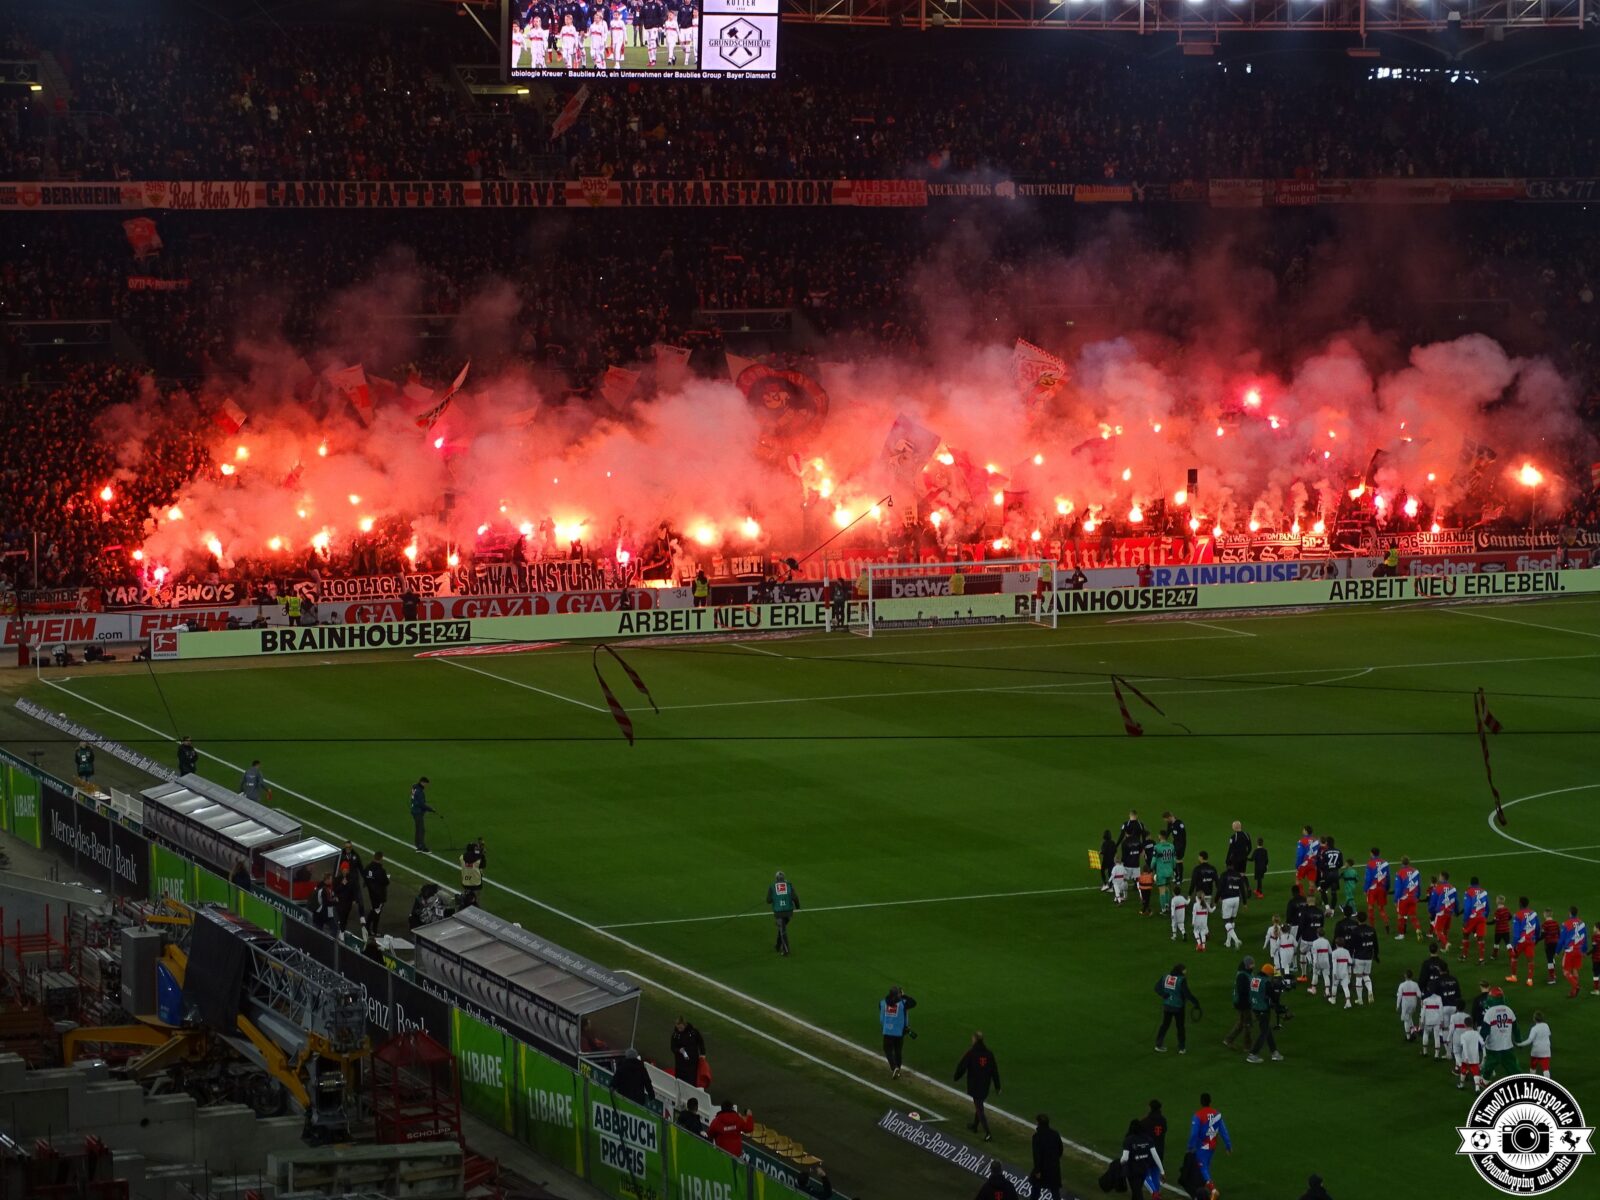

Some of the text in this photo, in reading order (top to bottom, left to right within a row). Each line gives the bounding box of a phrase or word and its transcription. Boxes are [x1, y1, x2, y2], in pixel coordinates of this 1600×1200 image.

[709, 39, 771, 48] GRUNDSCHMIEDE
[702, 71, 722, 80] Group
[727, 72, 745, 80] Bayer
[41, 186, 122, 205] BERKHEIM
[169, 181, 197, 209] Red
[233, 181, 251, 208] 96
[266, 182, 465, 208] CANNSTATTER
[481, 182, 567, 207] KURVE
[621, 181, 833, 206] NECKARSTADION
[928, 184, 992, 196] NECKAR-FILS
[1018, 183, 1075, 196] STUTTGART
[1478, 530, 1561, 549] Cannstatte
[176, 583, 235, 603] BWOYS
[320, 575, 435, 598] HOOLIGANS
[892, 577, 953, 598] betwa
[1329, 571, 1566, 601] ARBEIT NEU ERLEBEN.
[356, 601, 435, 624] GAI
[462, 597, 539, 618] GAZI
[618, 609, 706, 634] ARBEIT
[714, 605, 762, 629] NEU
[5, 617, 97, 645] EHEIM
[50, 808, 112, 870] Mercedes-Benz
[115, 844, 138, 885] Bank
[1327, 852, 1339, 866] 27
[461, 1050, 504, 1089] LIBARE
[528, 1087, 574, 1129] LIBARE
[594, 1104, 657, 1150] ABBRUCH
[877, 1109, 957, 1159] Mercedes-Benz
[951, 1145, 986, 1174] Bank
[602, 1138, 645, 1177] PROFIS
